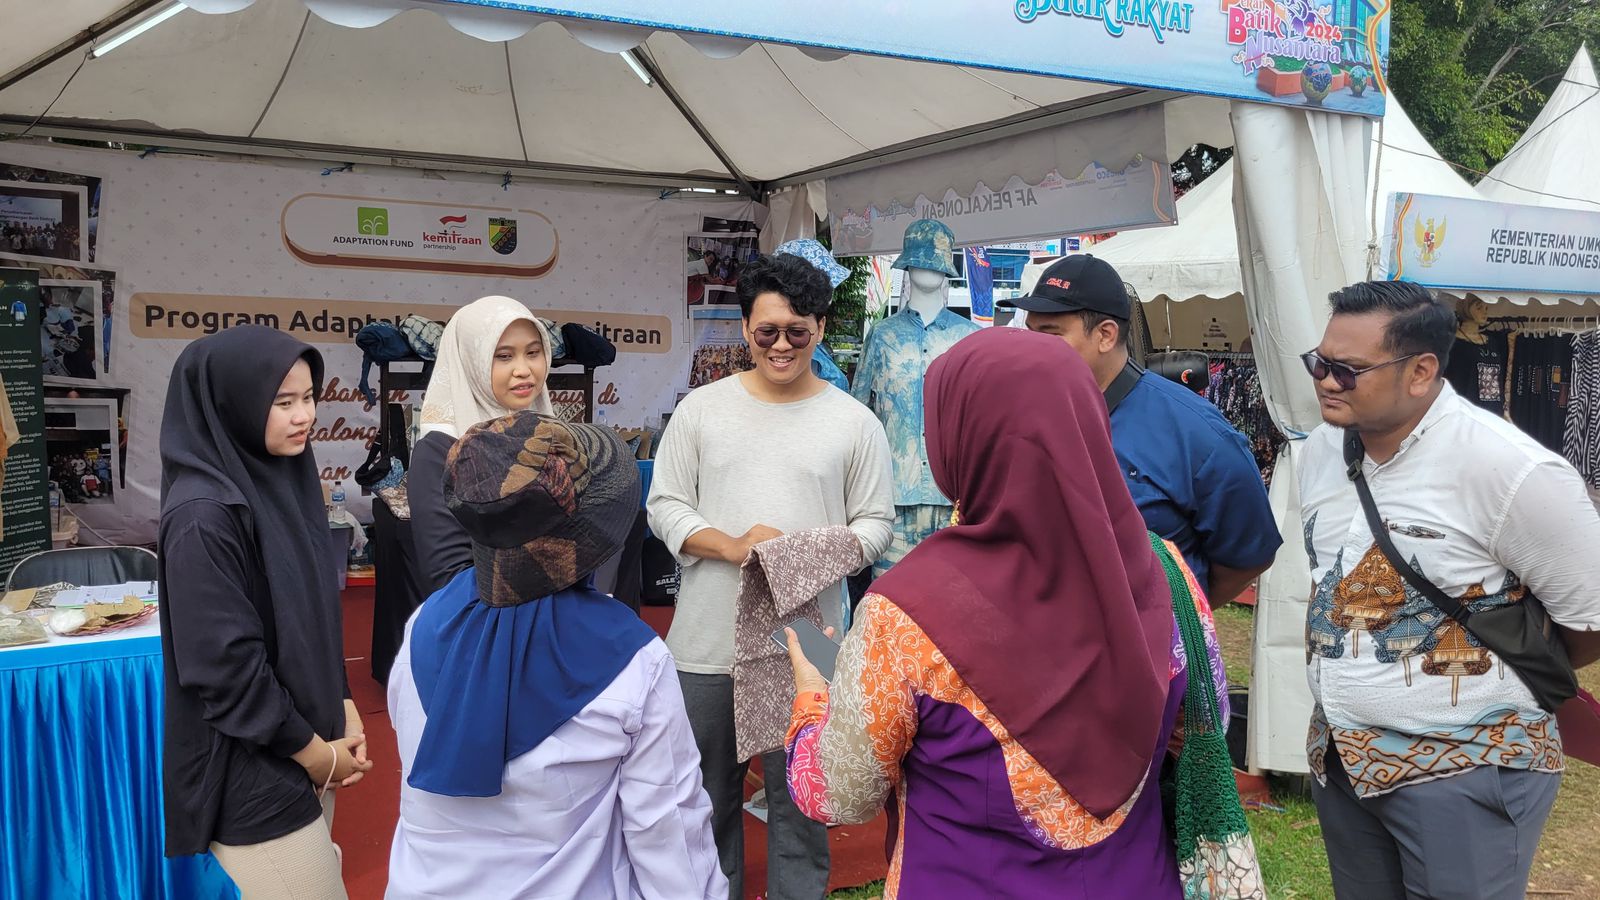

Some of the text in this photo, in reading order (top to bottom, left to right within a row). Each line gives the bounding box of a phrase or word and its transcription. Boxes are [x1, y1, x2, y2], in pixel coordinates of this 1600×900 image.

[1116, 0, 1193, 41] RAKYAT
[1229, 3, 1284, 43] Batik
[1306, 22, 1342, 41] 2024
[1243, 31, 1342, 74] Nusantara
[333, 235, 414, 248] ADAPTATION FUND
[423, 243, 456, 251] partnership
[1490, 229, 1575, 249] KEMENTERIAN
[1486, 247, 1547, 265] REPUBLIK
[145, 304, 279, 334] Program
[598, 382, 619, 405] di
